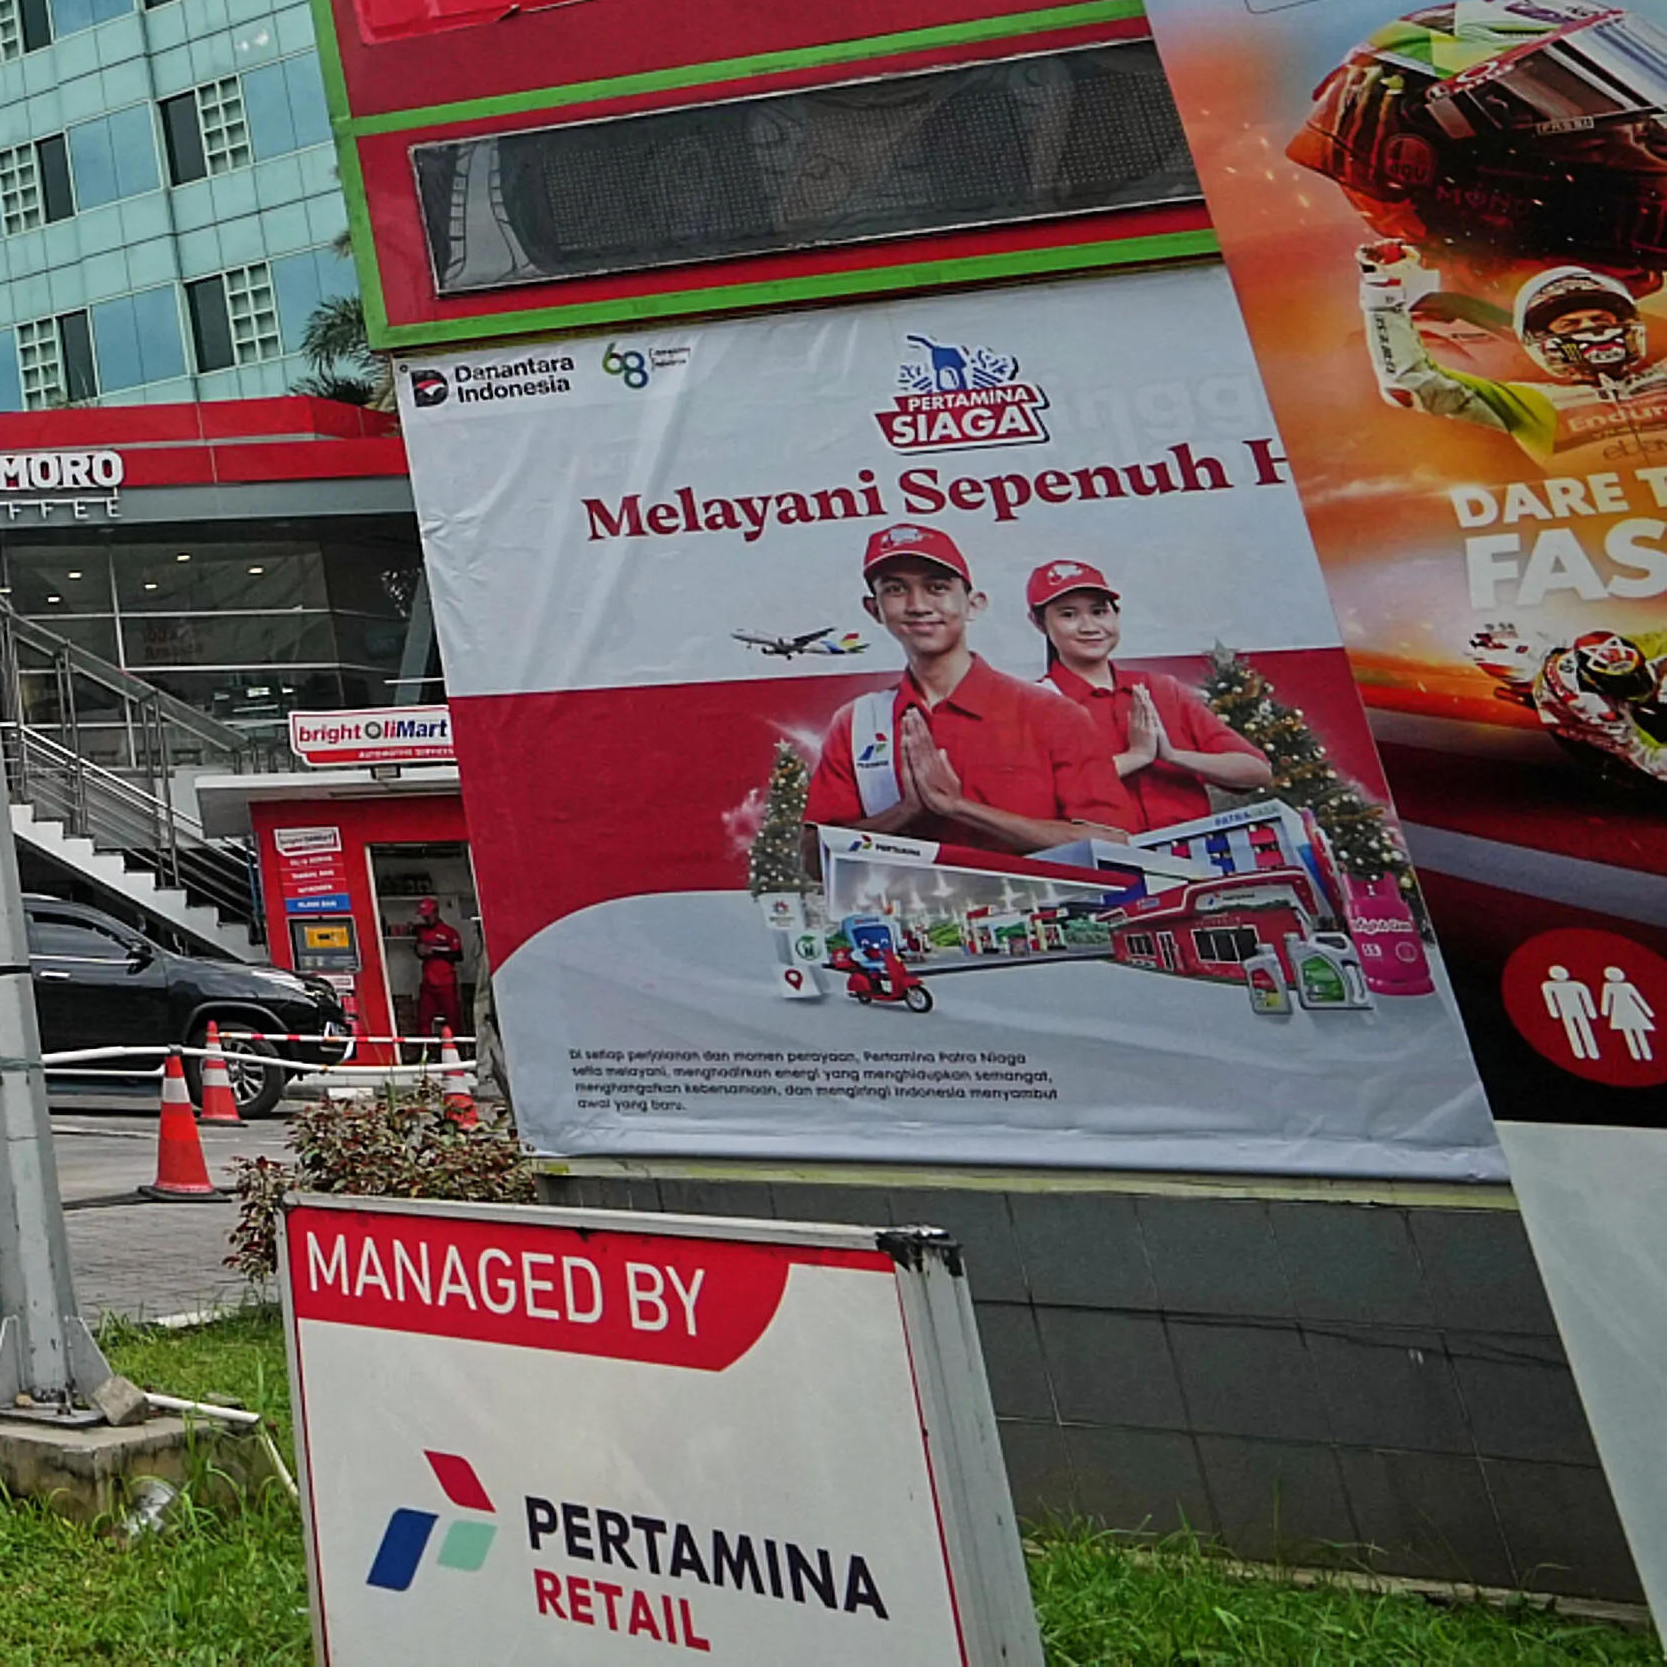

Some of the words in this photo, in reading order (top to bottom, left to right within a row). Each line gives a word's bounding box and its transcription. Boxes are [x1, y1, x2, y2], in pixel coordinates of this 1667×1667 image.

[454, 354, 575, 383] Danantara
[457, 375, 571, 403] Indonesia
[908, 387, 1030, 412] PERTAMINA
[892, 405, 1030, 444] SIAGA
[581, 469, 887, 544] Melayani
[899, 442, 1234, 526] Sepenuh
[1449, 472, 1630, 528] DARE
[299, 724, 361, 744] bright
[365, 719, 448, 739] OliMart
[306, 1230, 603, 1324] MANAGED
[626, 1262, 706, 1337] BY
[526, 1496, 890, 1621] PERTAMINA
[533, 1567, 711, 1652] RETAIL
